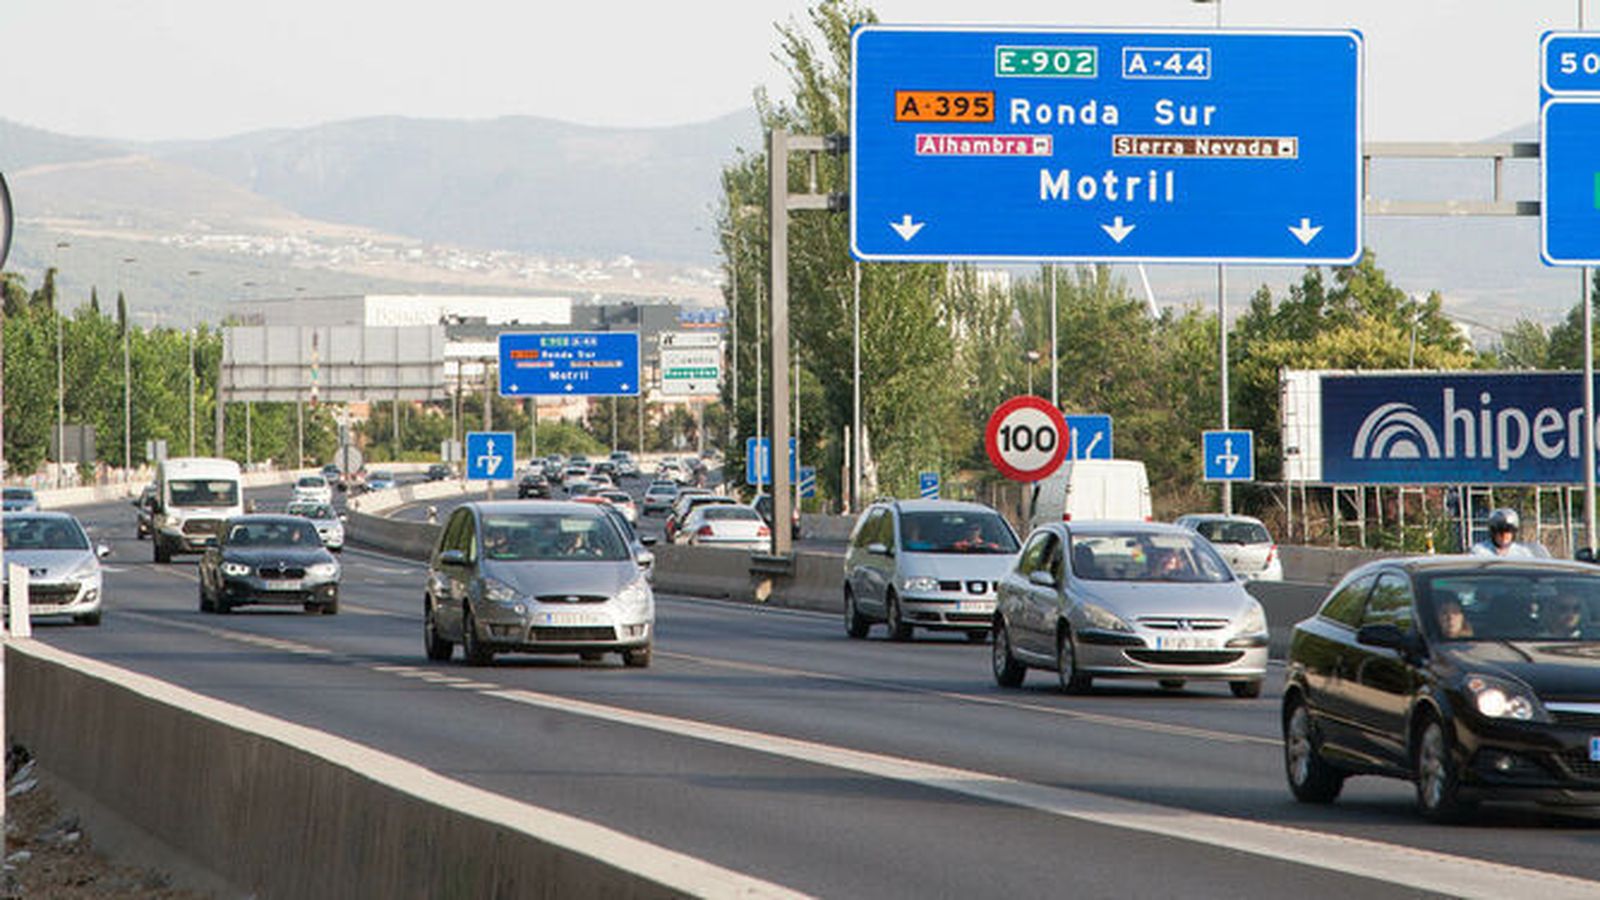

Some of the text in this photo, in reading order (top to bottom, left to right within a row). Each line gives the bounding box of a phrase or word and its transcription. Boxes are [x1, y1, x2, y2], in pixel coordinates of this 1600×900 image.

[1000, 52, 1205, 74] E-902 A-44
[901, 97, 1215, 126] A-395 Ronda Sur
[923, 137, 1027, 153] Alhambra
[1117, 139, 1272, 155] Sierra Nevada
[1041, 170, 1173, 201] Motril
[549, 370, 589, 380] Motril
[1000, 425, 1056, 453] 100
[1443, 387, 1600, 470] hiper
